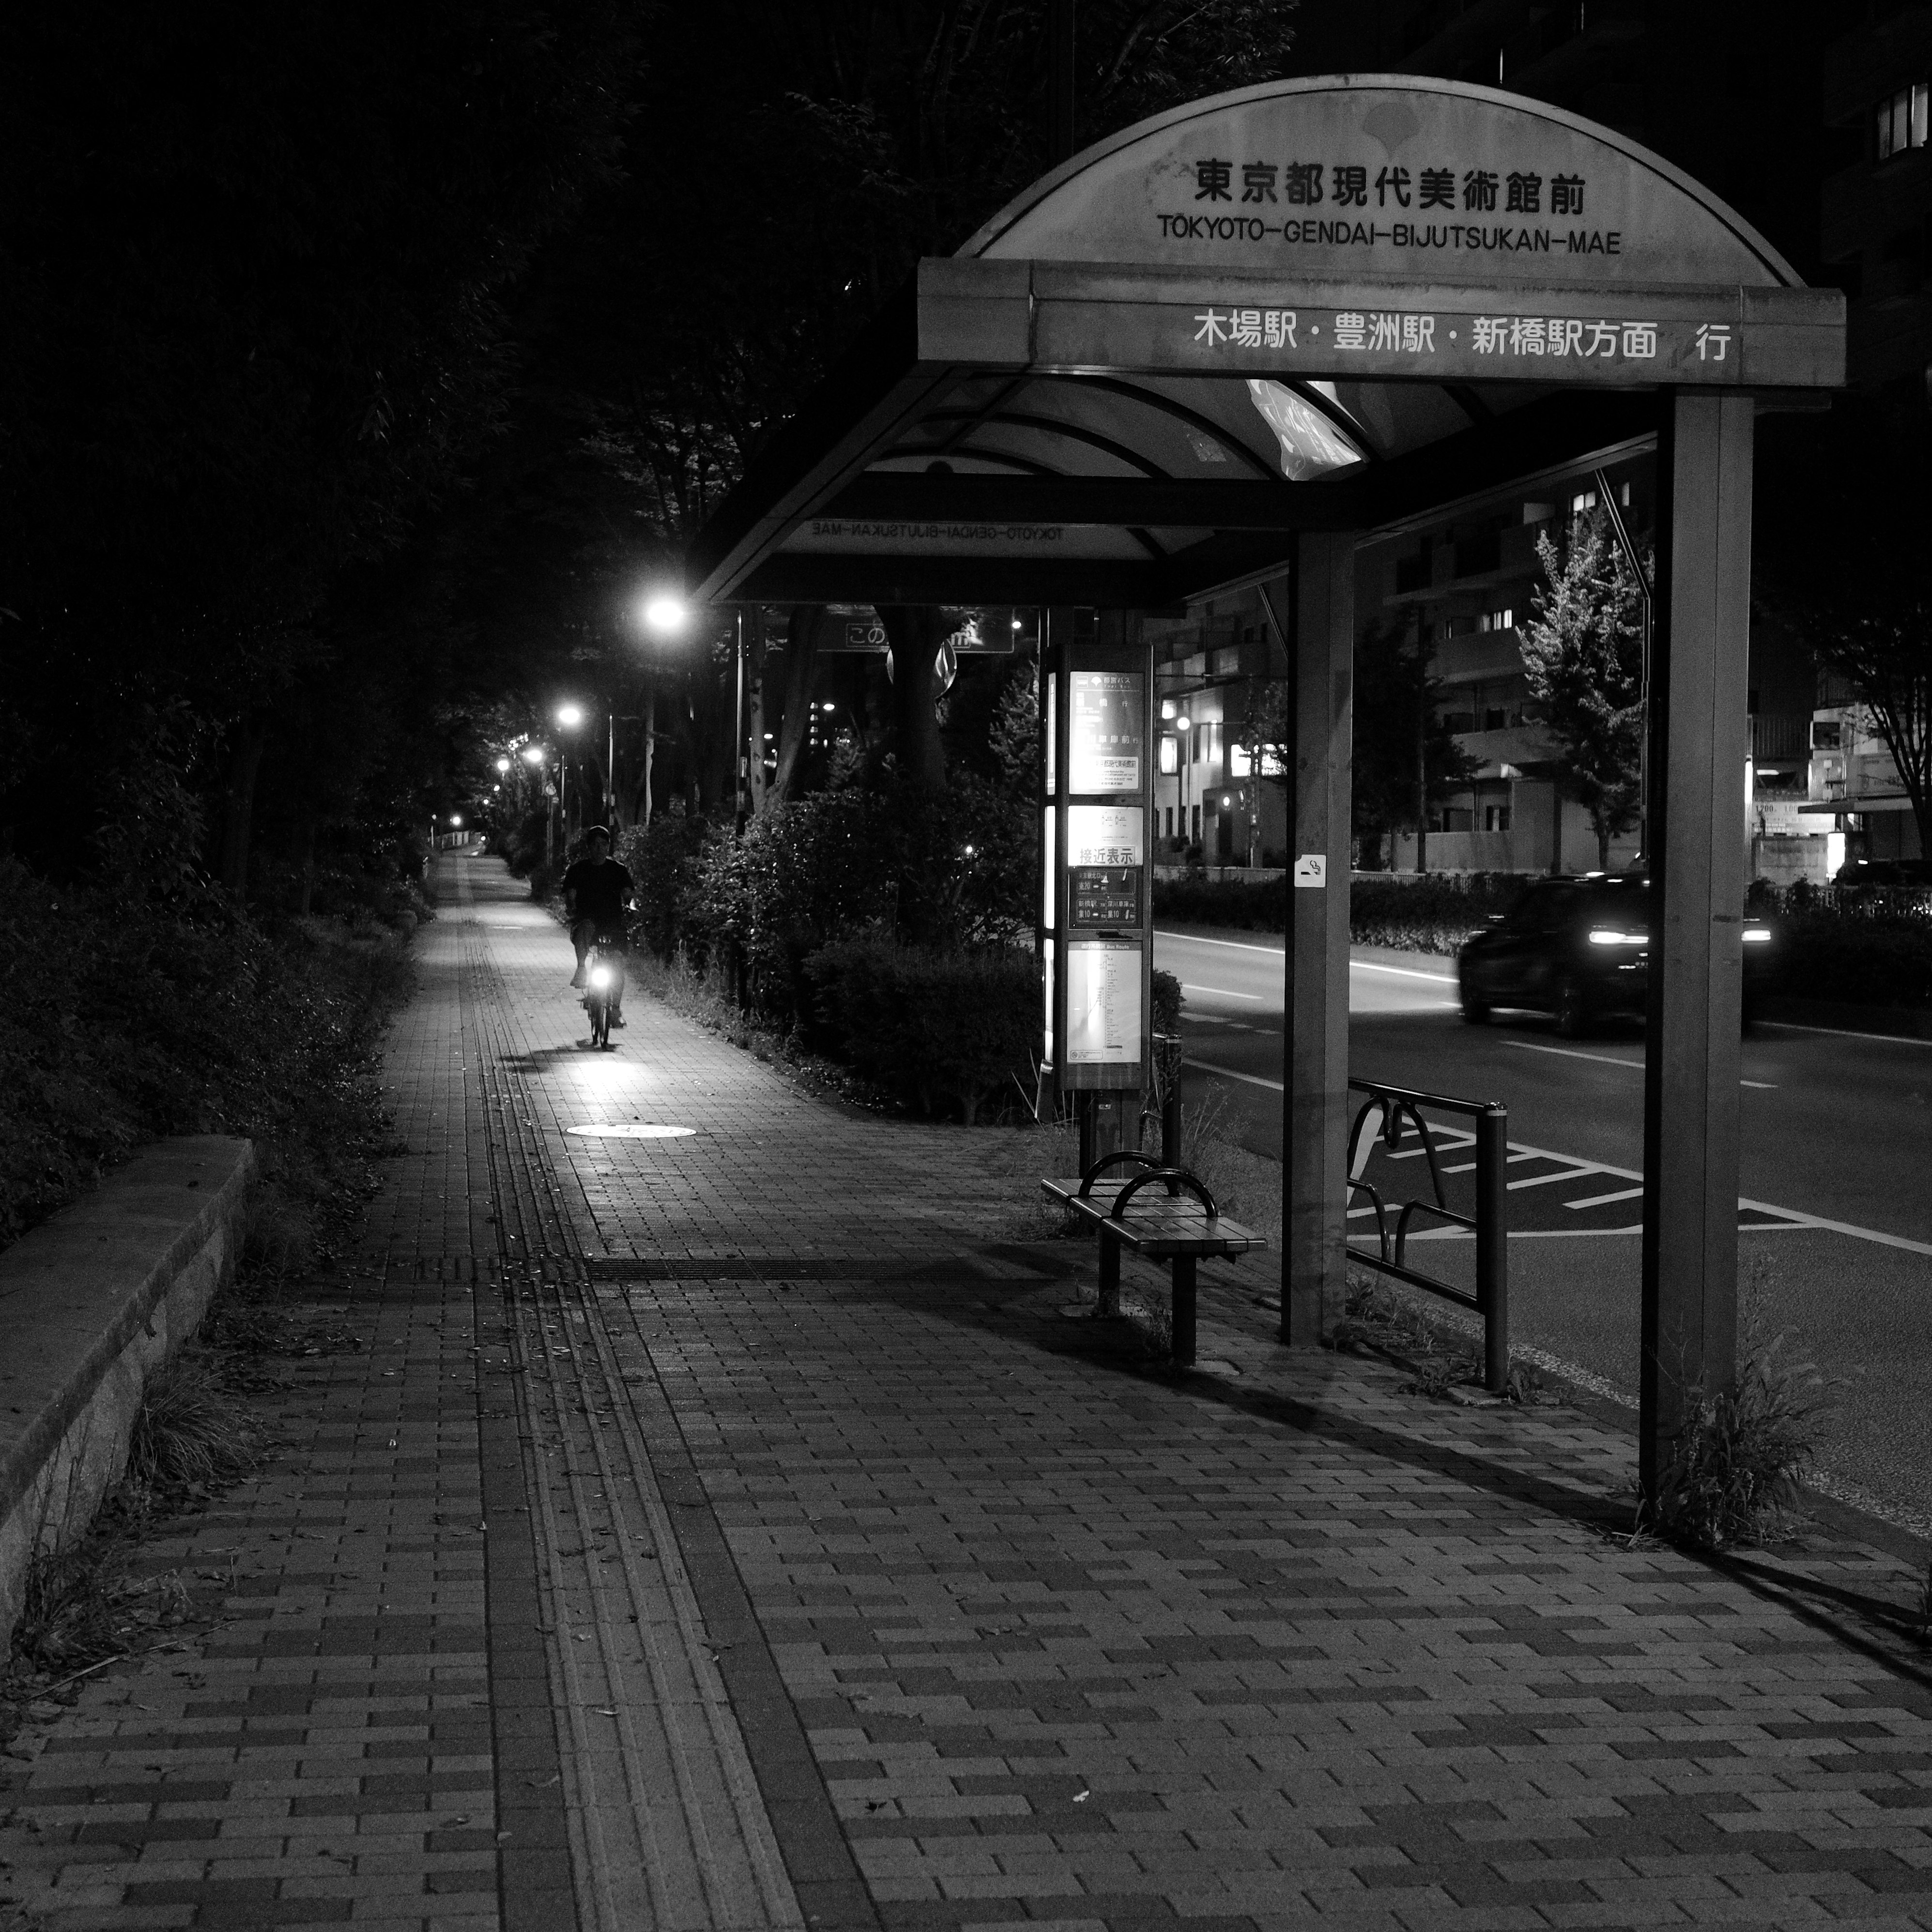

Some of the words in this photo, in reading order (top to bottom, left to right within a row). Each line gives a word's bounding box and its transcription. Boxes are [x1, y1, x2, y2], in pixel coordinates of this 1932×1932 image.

[1196, 158, 1585, 215] 東京都現代美術館前
[1158, 214, 1621, 255] TOKYOTO-GENDAI-BIJUTSUKAN-MAE
[1194, 308, 1658, 359] 木場駅・豊洲駅・新橋駅方面
[1695, 324, 1731, 361] 行
[849, 627, 889, 644] この
[1080, 847, 1133, 864] 接近表示
